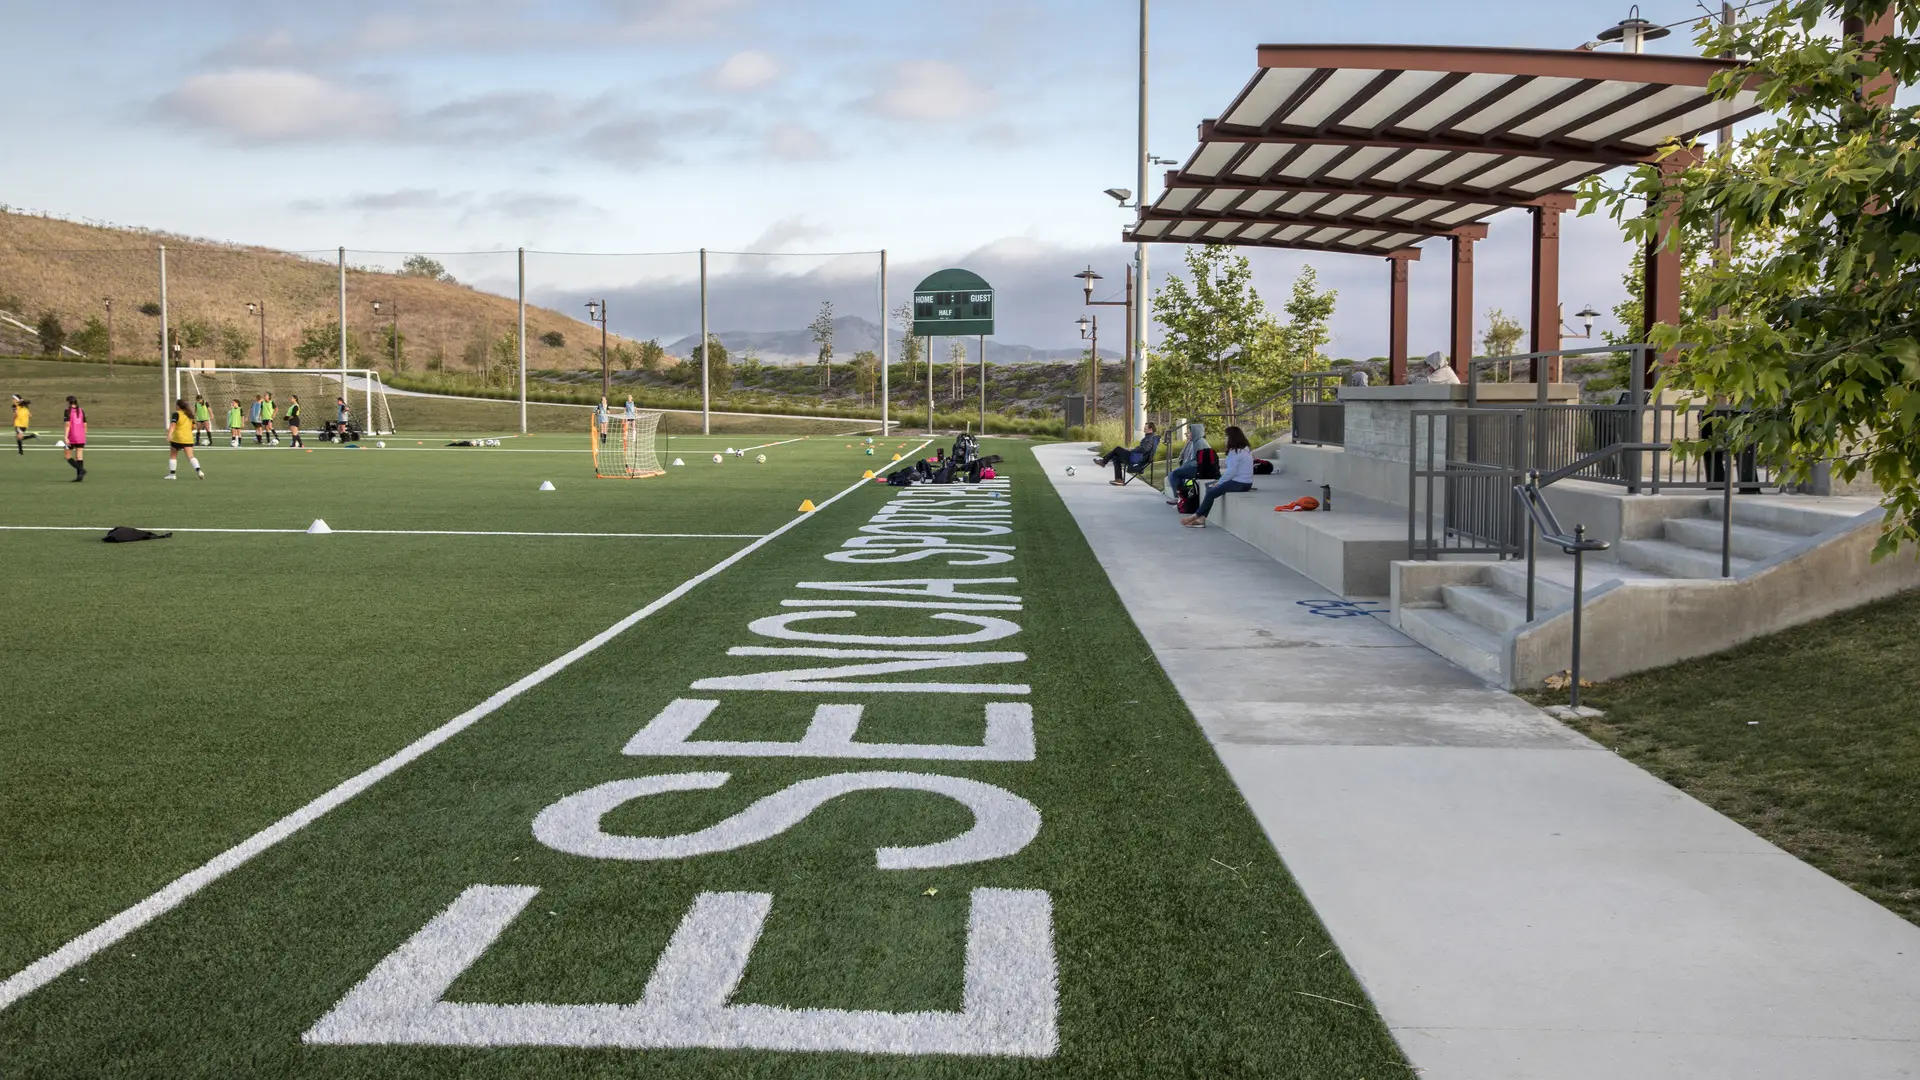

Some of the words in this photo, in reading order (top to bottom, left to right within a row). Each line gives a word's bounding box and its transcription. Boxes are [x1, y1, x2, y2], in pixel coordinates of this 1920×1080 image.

[915, 295, 934, 304] HOME
[970, 294, 991, 302] GUEST
[301, 577, 1062, 1059] ESENCIA
[823, 499, 1016, 565] SPORTS
